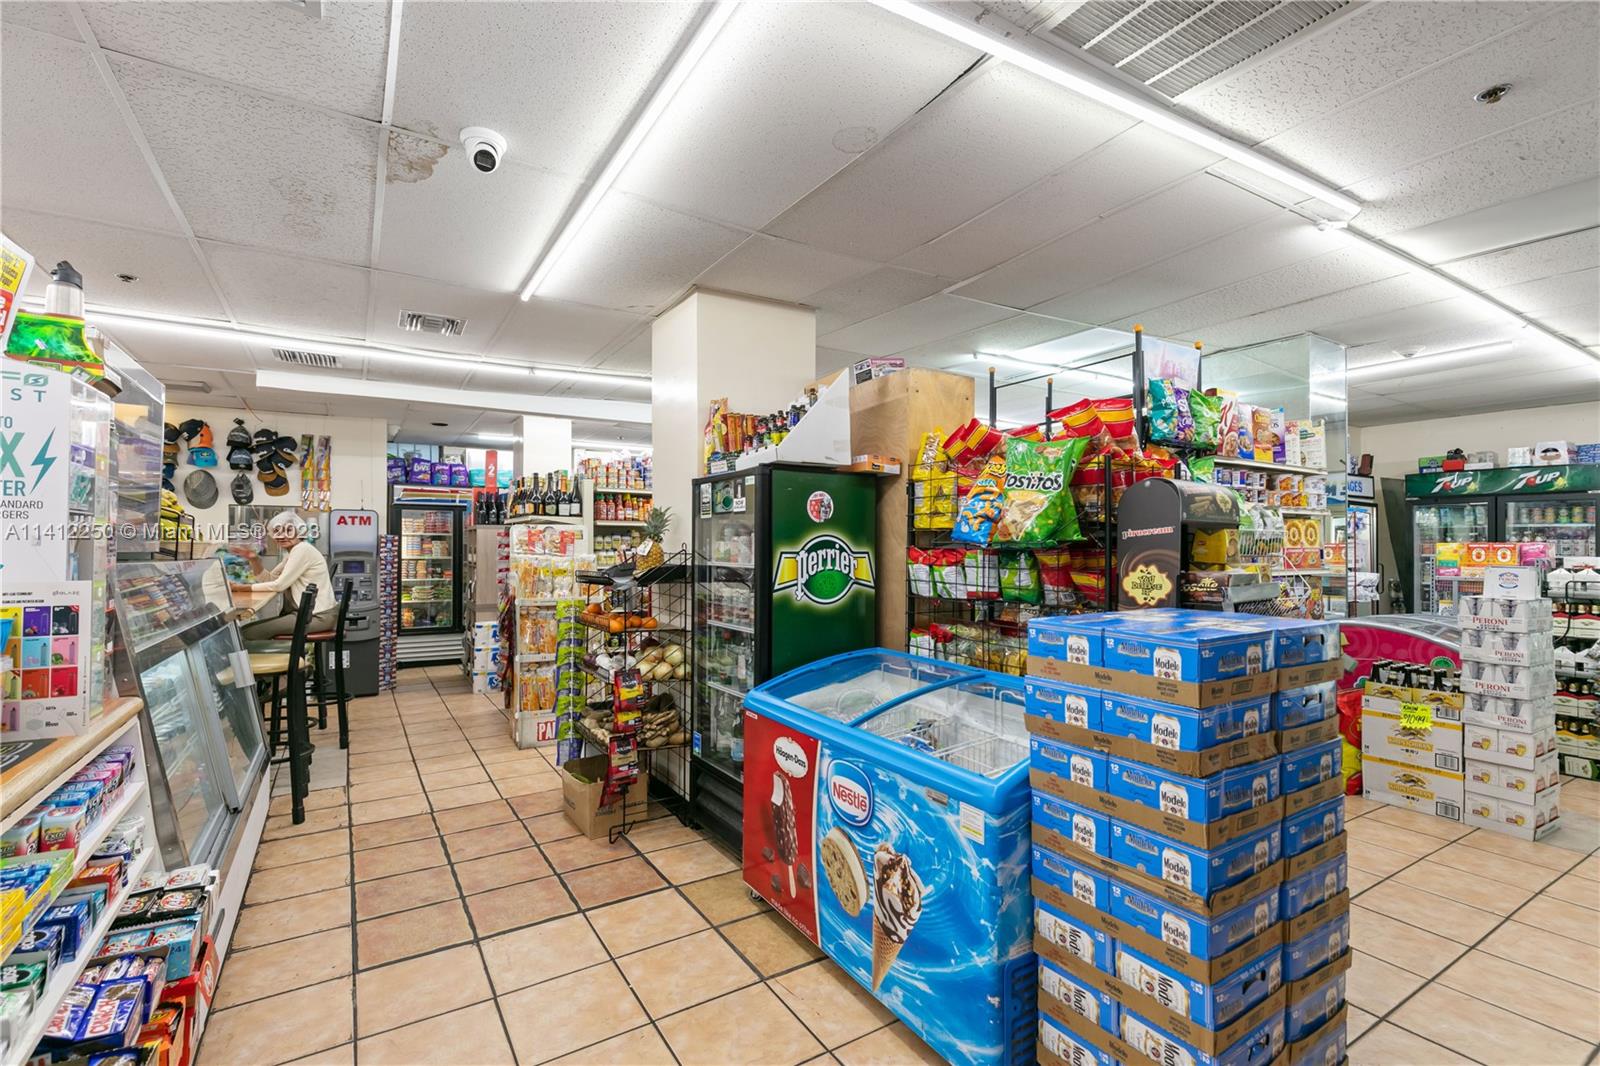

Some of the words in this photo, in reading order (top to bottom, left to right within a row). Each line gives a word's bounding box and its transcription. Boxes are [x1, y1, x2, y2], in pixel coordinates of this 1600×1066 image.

[488, 464, 497, 477] 2
[1513, 469, 1561, 491] 7UP
[336, 515, 372, 526] ATM
[1472, 616, 1509, 626] PERONI
[1494, 650, 1525, 659] PERONI
[1475, 682, 1511, 693] PERONI
[1497, 715, 1528, 726] PERONI
[1113, 825, 1122, 833] 12
[1163, 857, 1189, 874] Modelo
